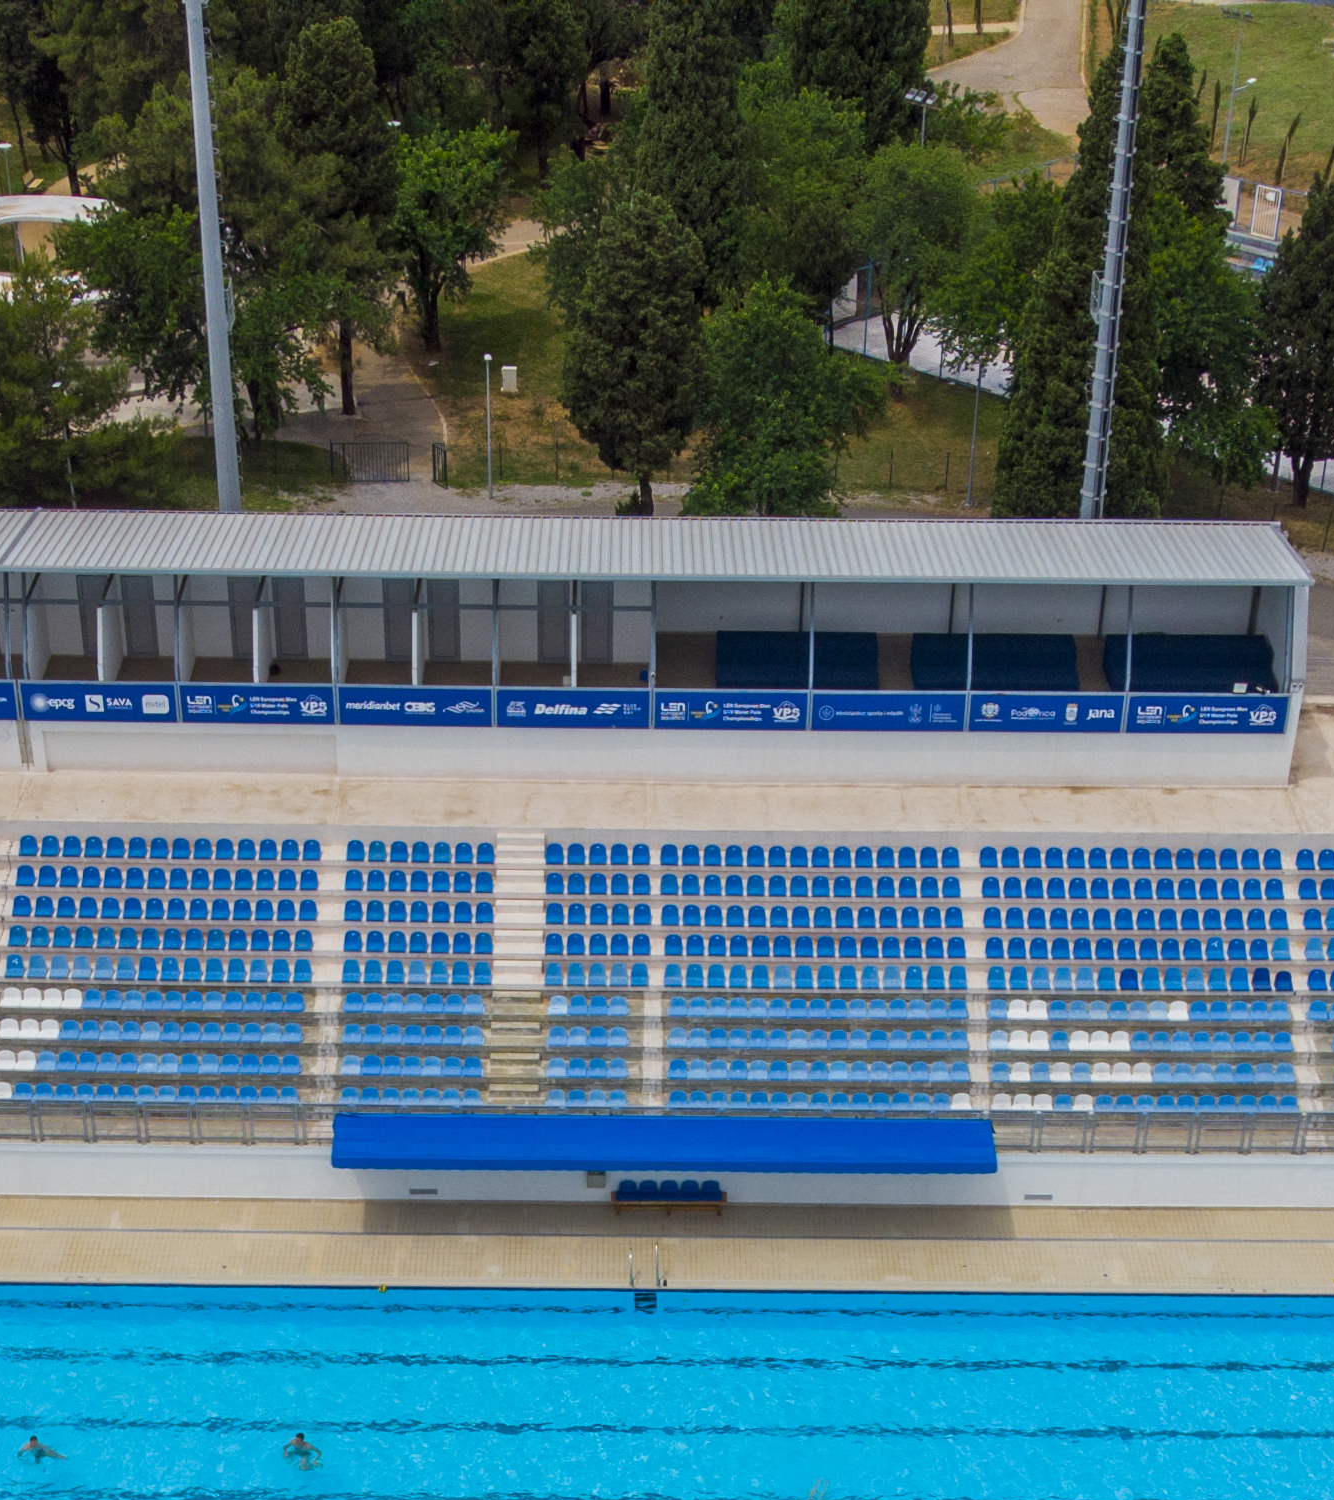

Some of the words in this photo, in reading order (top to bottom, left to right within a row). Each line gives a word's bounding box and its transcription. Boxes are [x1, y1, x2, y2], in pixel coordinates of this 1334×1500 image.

[48, 698, 75, 710] epcg
[106, 698, 133, 706] SAVA
[300, 702, 328, 712] VPS
[346, 701, 400, 710] meridianbet
[534, 704, 588, 715] Delfina
[773, 708, 800, 718] VPS
[1250, 711, 1277, 721] VPS
